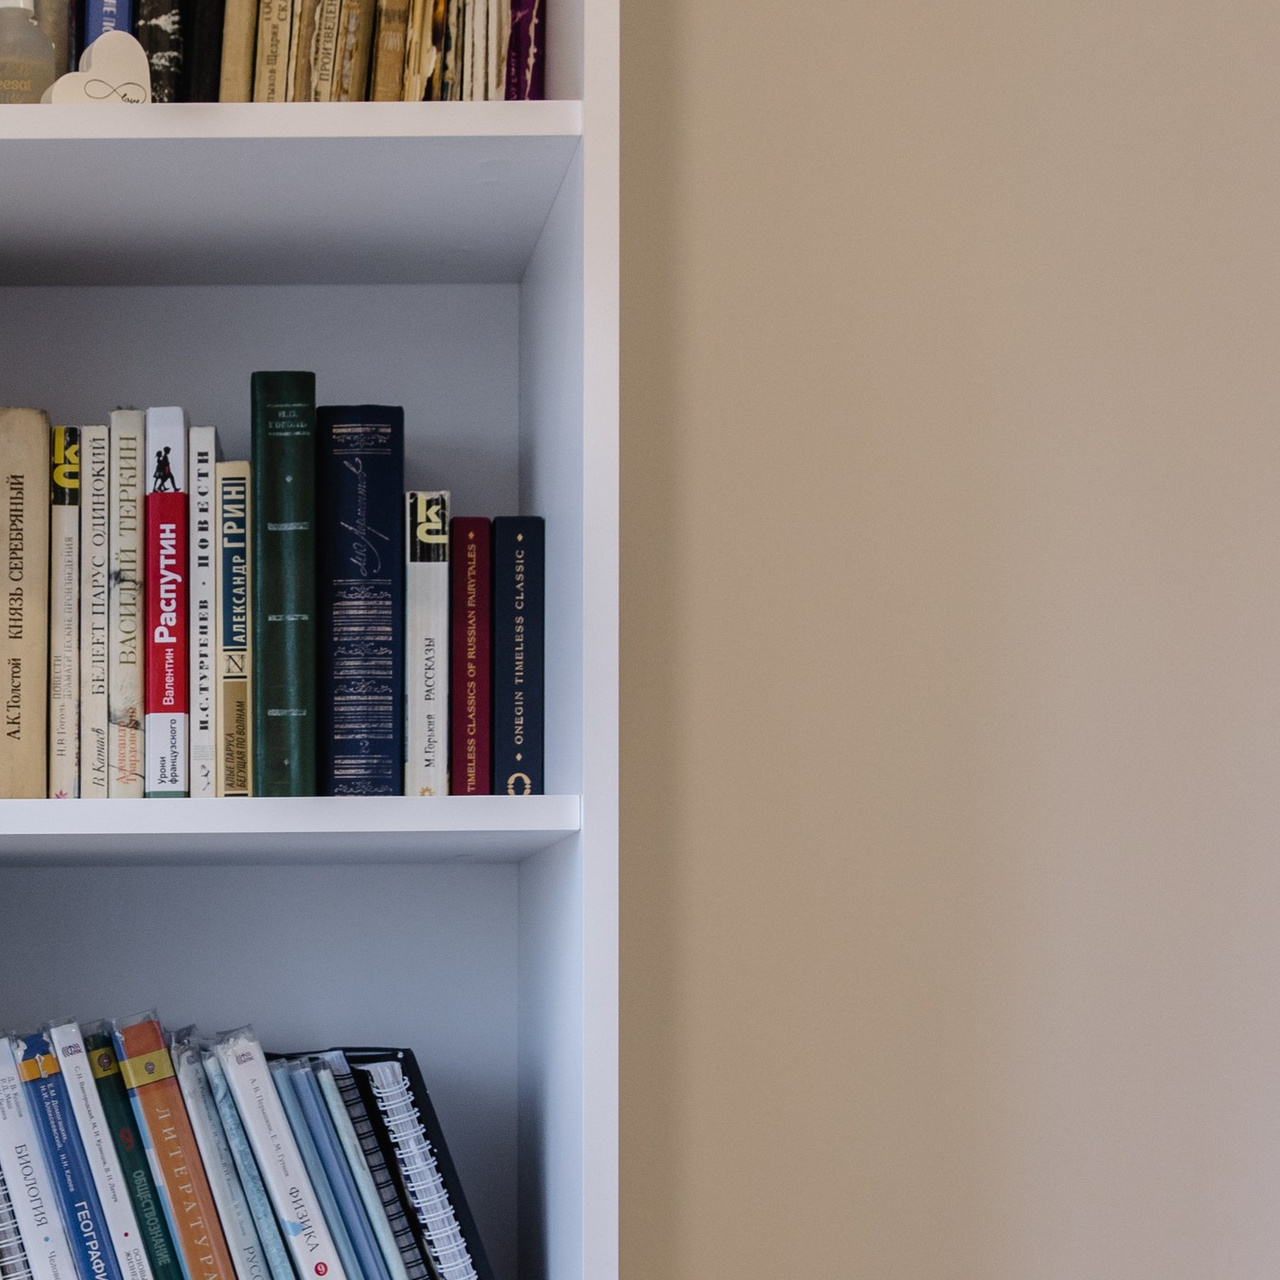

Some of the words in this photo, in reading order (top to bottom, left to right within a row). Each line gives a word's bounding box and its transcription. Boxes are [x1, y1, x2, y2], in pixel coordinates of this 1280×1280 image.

[102, 0, 118, 14] НЕ
[121, 93, 140, 104] love
[90, 440, 106, 550] ОДИНОКИЙ
[118, 438, 138, 540] ТЕРКИН
[198, 450, 210, 567] ПОВЕСТИ
[223, 487, 246, 551] ГРИН
[6, 474, 24, 583] СЕРЕБРЯНЫЙ
[91, 558, 105, 619] ПАРУС
[154, 524, 182, 644] Распутин
[232, 557, 247, 645] АЛЕКСАНДР
[466, 543, 476, 607] FAIRYTALES
[514, 549, 524, 610] CLASSIC
[8, 586, 24, 640] КНЯЗЬ
[117, 550, 139, 669] ВАСИЛИЙ
[466, 610, 476, 659] RUSSIAN
[91, 627, 105, 698] БЕЛЕЕТ
[162, 648, 176, 706] Валентин
[424, 637, 436, 701] РАССКАЗЫ
[466, 661, 476, 678] OF
[514, 616, 524, 685] TIMELESS
[236, 703, 247, 738] ВОЛНАМ
[466, 681, 476, 735] CLASSICS
[514, 691, 524, 745] ONEGIN
[91, 730, 106, 776] Катаев
[157, 756, 169, 785] Уроки
[167, 718, 179, 785] французского
[225, 734, 236, 765] ПАРУСА
[235, 753, 248, 791] БЕГУЩАЯ
[236, 739, 247, 752] ПО
[466, 739, 476, 793] TIMELESS
[225, 767, 235, 791] АЛЫЕ
[14, 1142, 49, 1227] БИОЛОГИЯ
[132, 1169, 170, 1266] ОБЩЕСТВОЗНАНИЕ
[288, 1186, 320, 1252] ФИЗИКА
